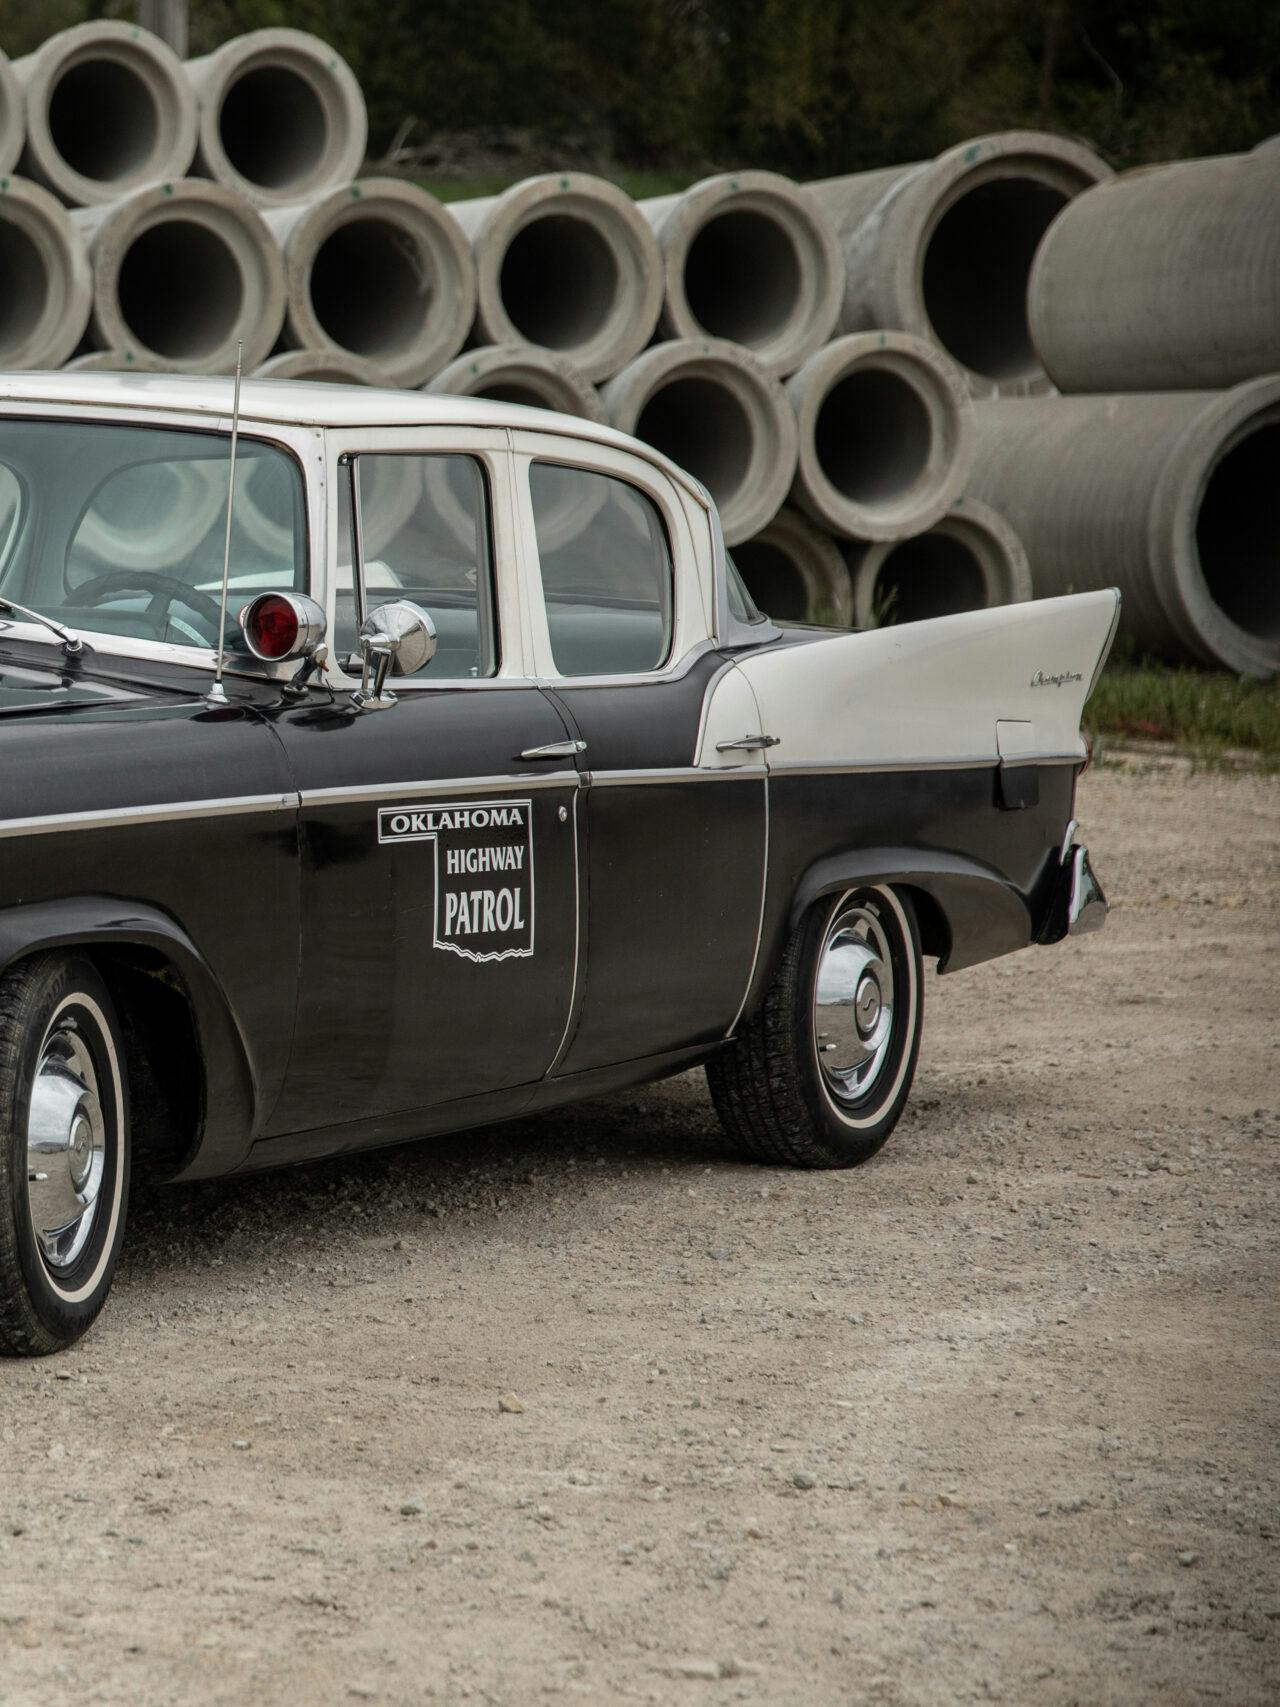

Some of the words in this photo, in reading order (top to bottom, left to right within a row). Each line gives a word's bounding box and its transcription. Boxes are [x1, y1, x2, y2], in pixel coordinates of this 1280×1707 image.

[390, 808, 524, 833] OKLAHOMA
[446, 845, 524, 874] HIGHWAY
[444, 887, 524, 935] PATROL
